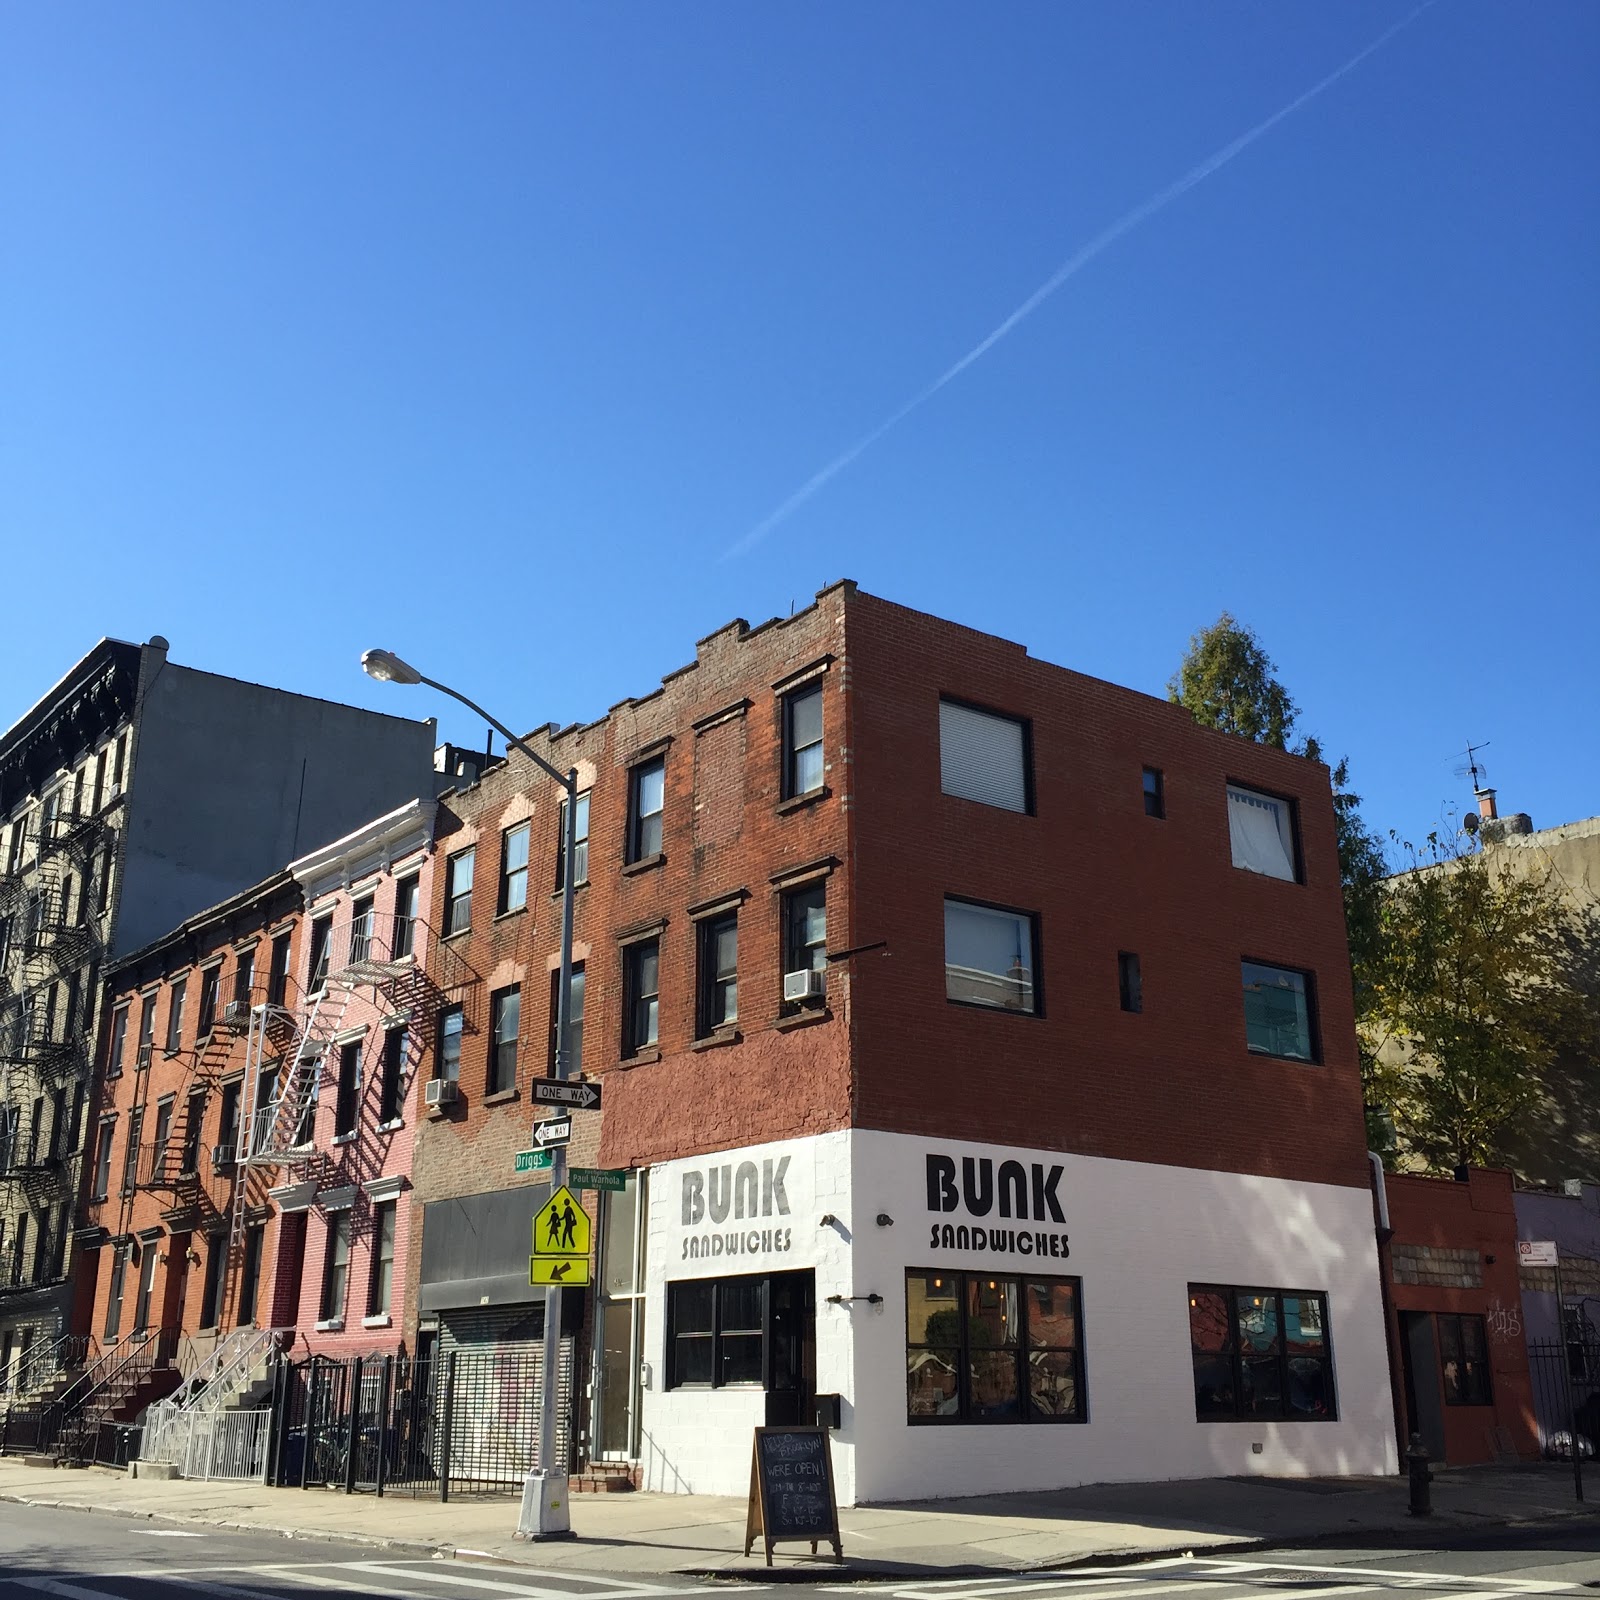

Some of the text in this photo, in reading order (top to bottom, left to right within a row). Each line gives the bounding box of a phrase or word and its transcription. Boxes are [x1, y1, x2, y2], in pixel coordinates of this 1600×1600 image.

[541, 1086, 592, 1102] ONE WAY
[538, 1124, 567, 1140] ONE WAY
[516, 1152, 543, 1170] Driggs
[572, 1173, 620, 1185] Paul Warhola
[681, 1155, 792, 1226] BUNK
[926, 1153, 1067, 1224] BUNK
[682, 1227, 792, 1261] SANDWICHES
[930, 1223, 1070, 1259] SANDWICHES
